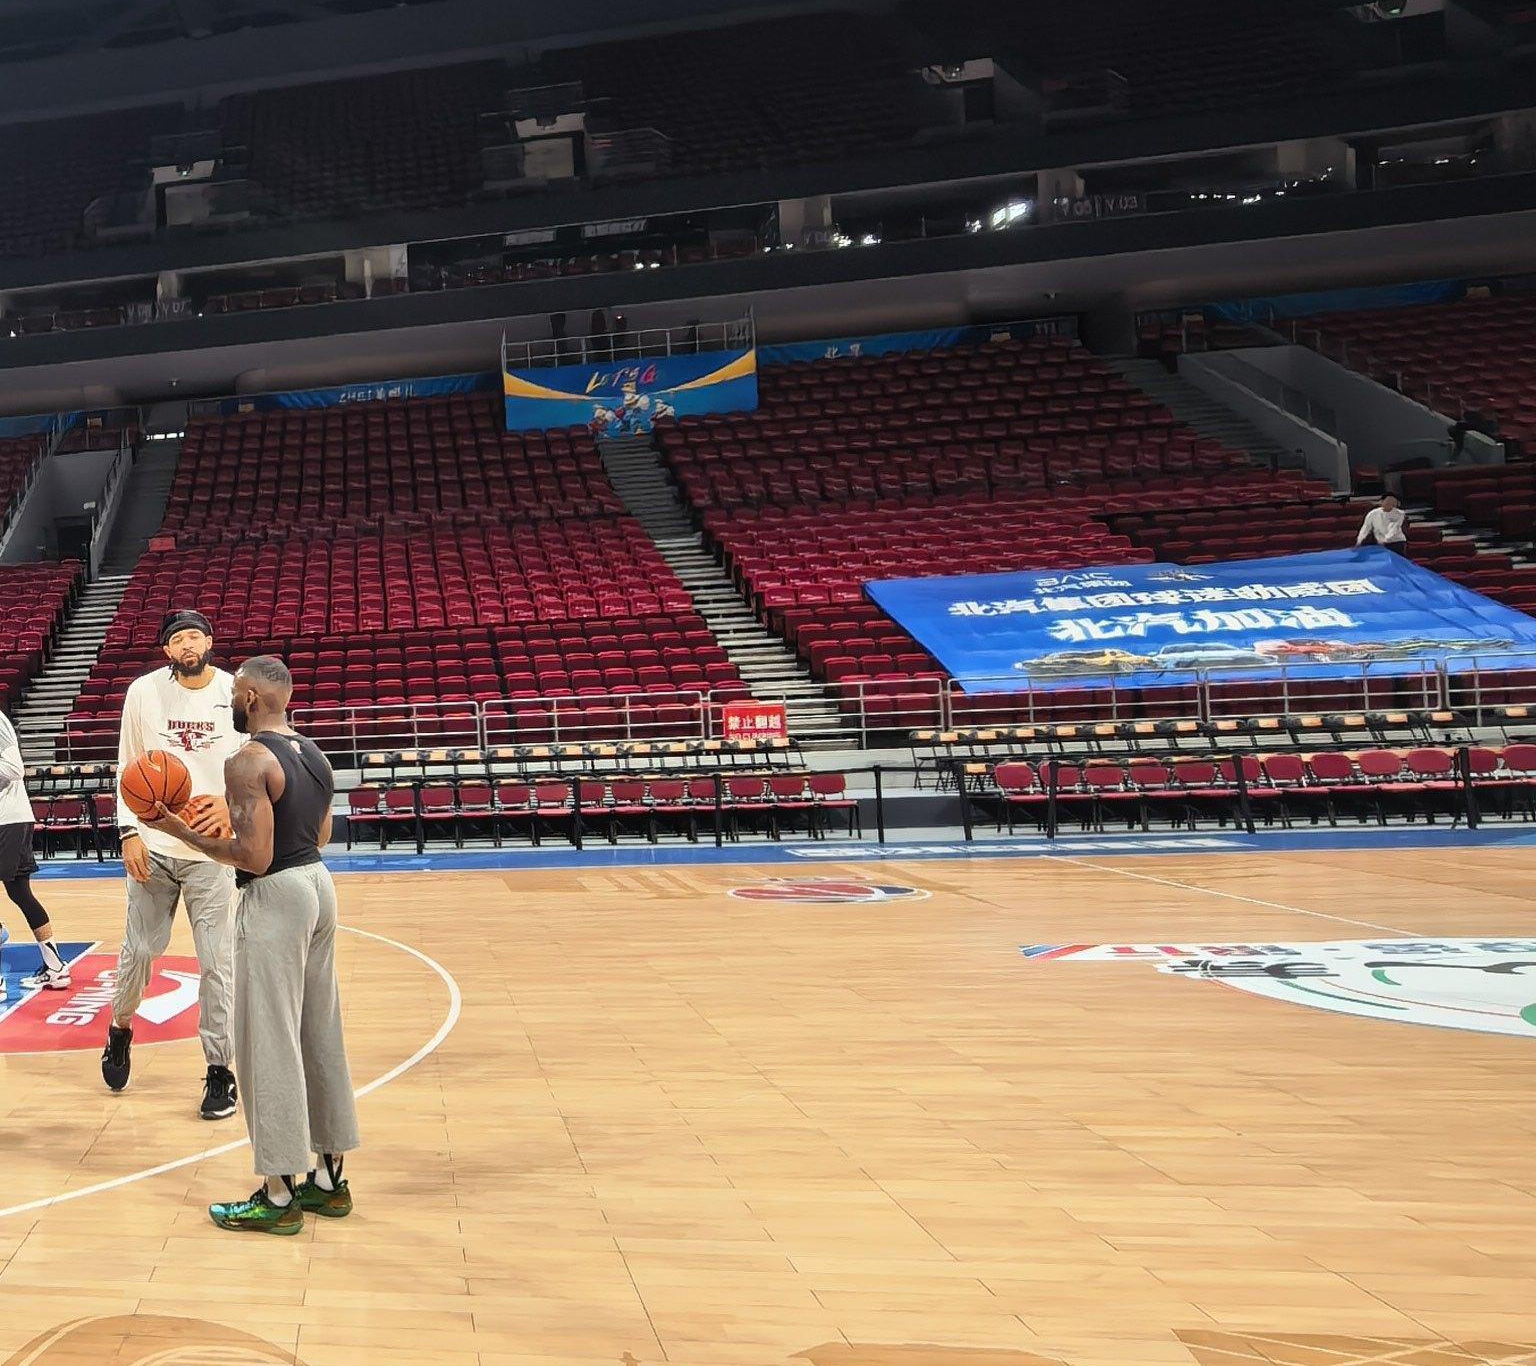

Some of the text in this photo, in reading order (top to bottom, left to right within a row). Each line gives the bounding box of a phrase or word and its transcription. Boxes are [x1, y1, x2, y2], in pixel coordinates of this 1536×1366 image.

[1035, 572, 1113, 586] BAIC
[1046, 605, 1363, 643] 北汽加油
